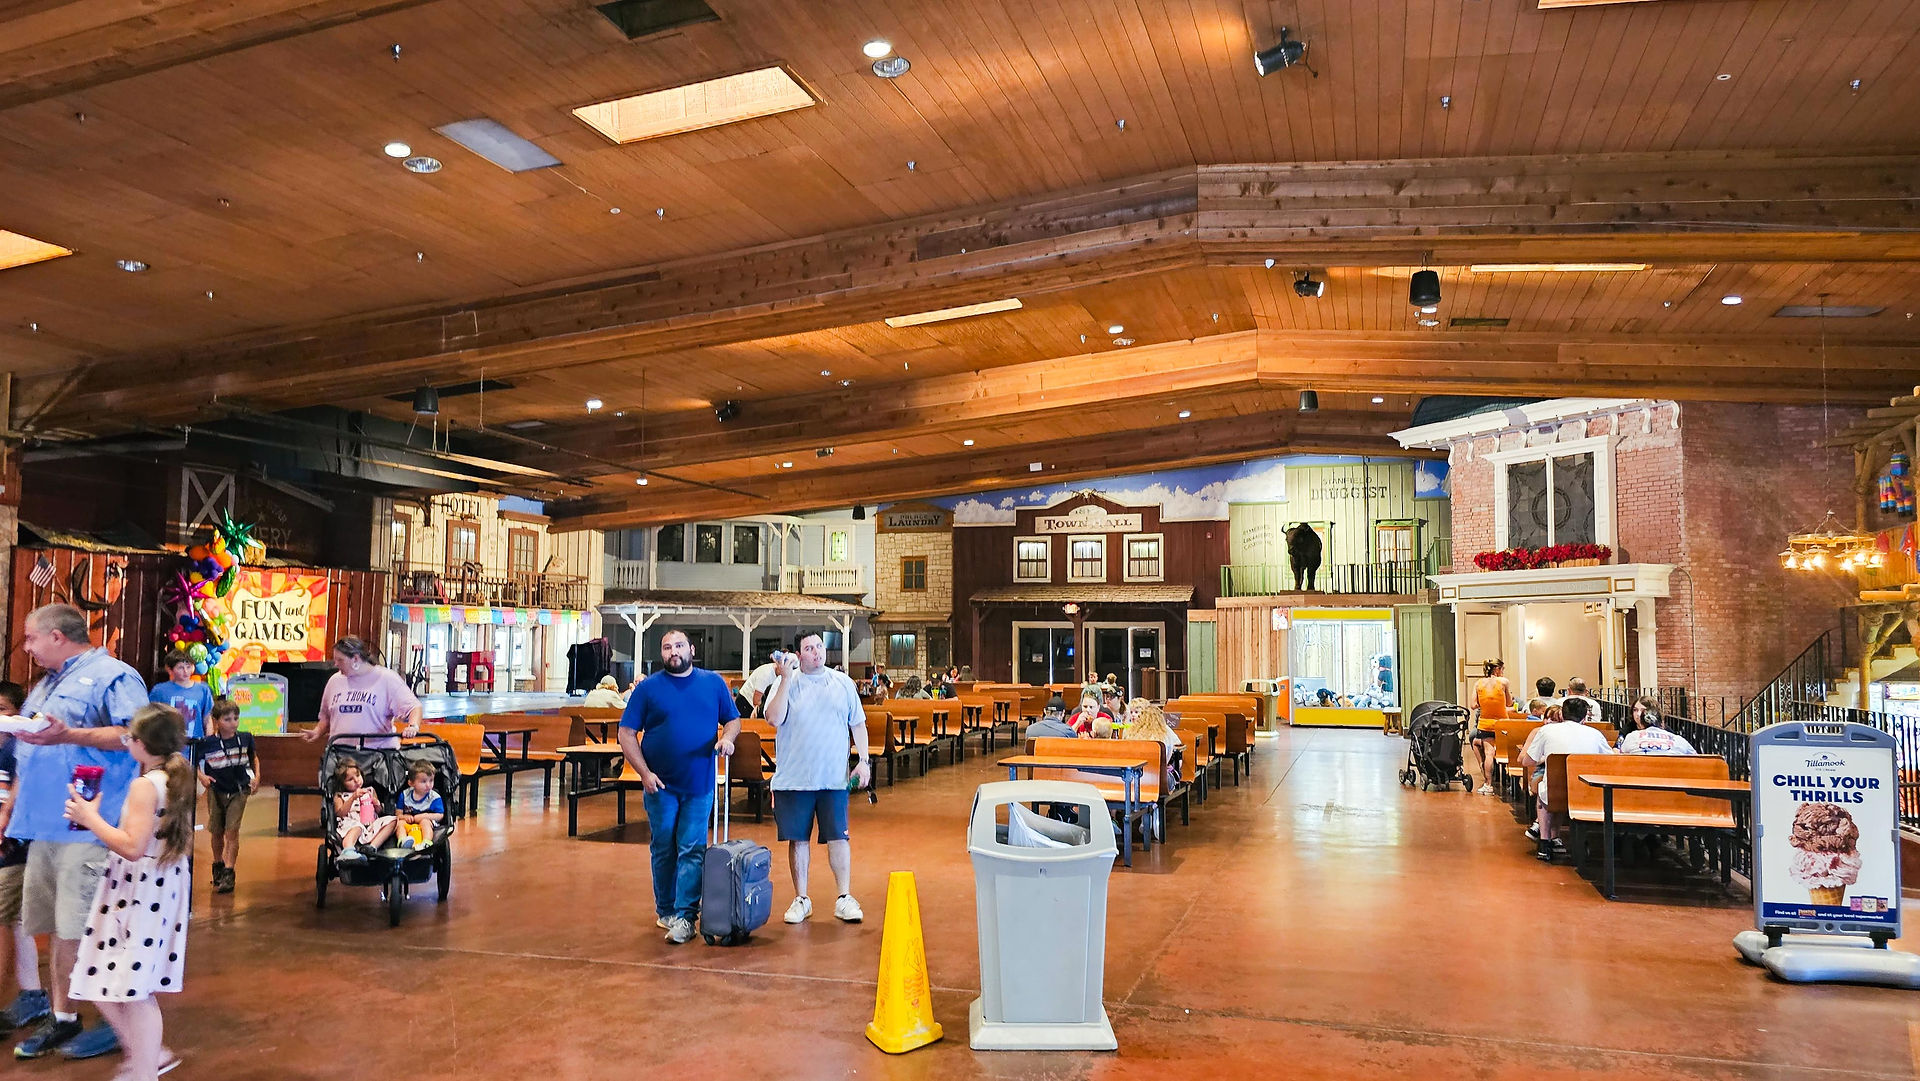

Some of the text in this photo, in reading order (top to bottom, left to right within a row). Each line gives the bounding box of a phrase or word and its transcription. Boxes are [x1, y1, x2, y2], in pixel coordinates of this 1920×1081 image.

[1311, 486, 1388, 501] DRUGGIST
[441, 495, 480, 517] HOTEL
[888, 515, 940, 527] LAUNDRY
[1044, 518, 1132, 531] TOWN ALL
[241, 600, 304, 620] FUN and
[235, 621, 304, 642] GAMES
[346, 691, 377, 706] THOMAS
[1805, 759, 1845, 768] Tillamook
[1773, 774, 1880, 790] CHILL YOUR
[1790, 790, 1864, 804] THRILLS
